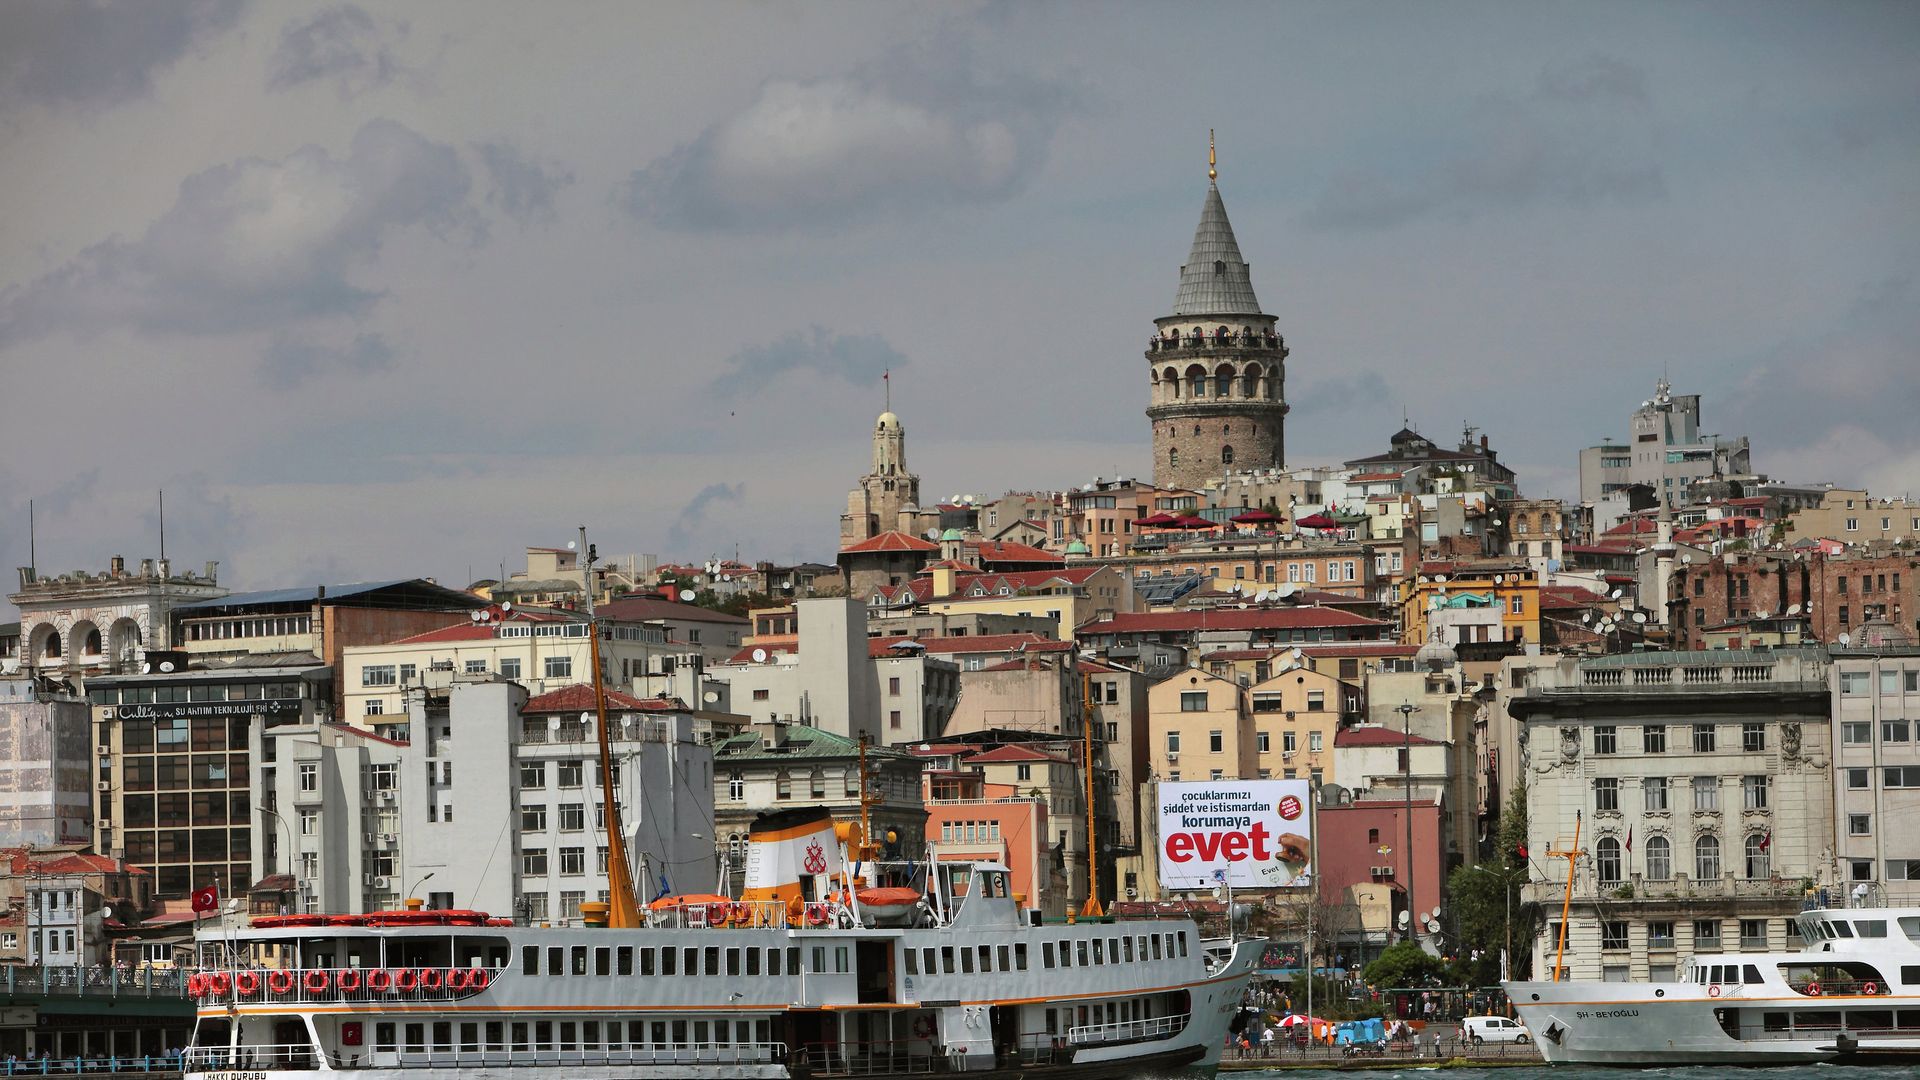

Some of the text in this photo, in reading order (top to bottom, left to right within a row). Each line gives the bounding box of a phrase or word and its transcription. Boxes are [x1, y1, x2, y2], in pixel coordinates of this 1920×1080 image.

[176, 707, 186, 716] SU
[1182, 791, 1250, 802] çocuklarımızı
[1164, 804, 1194, 815] şiddet
[1197, 804, 1208, 812] ve
[1210, 802, 1270, 812] istismardan
[1182, 815, 1250, 829] korumaya
[1166, 821, 1270, 863] evet
[1261, 866, 1280, 876] Evet
[1596, 1010, 1639, 1018] BEYOĞLU
